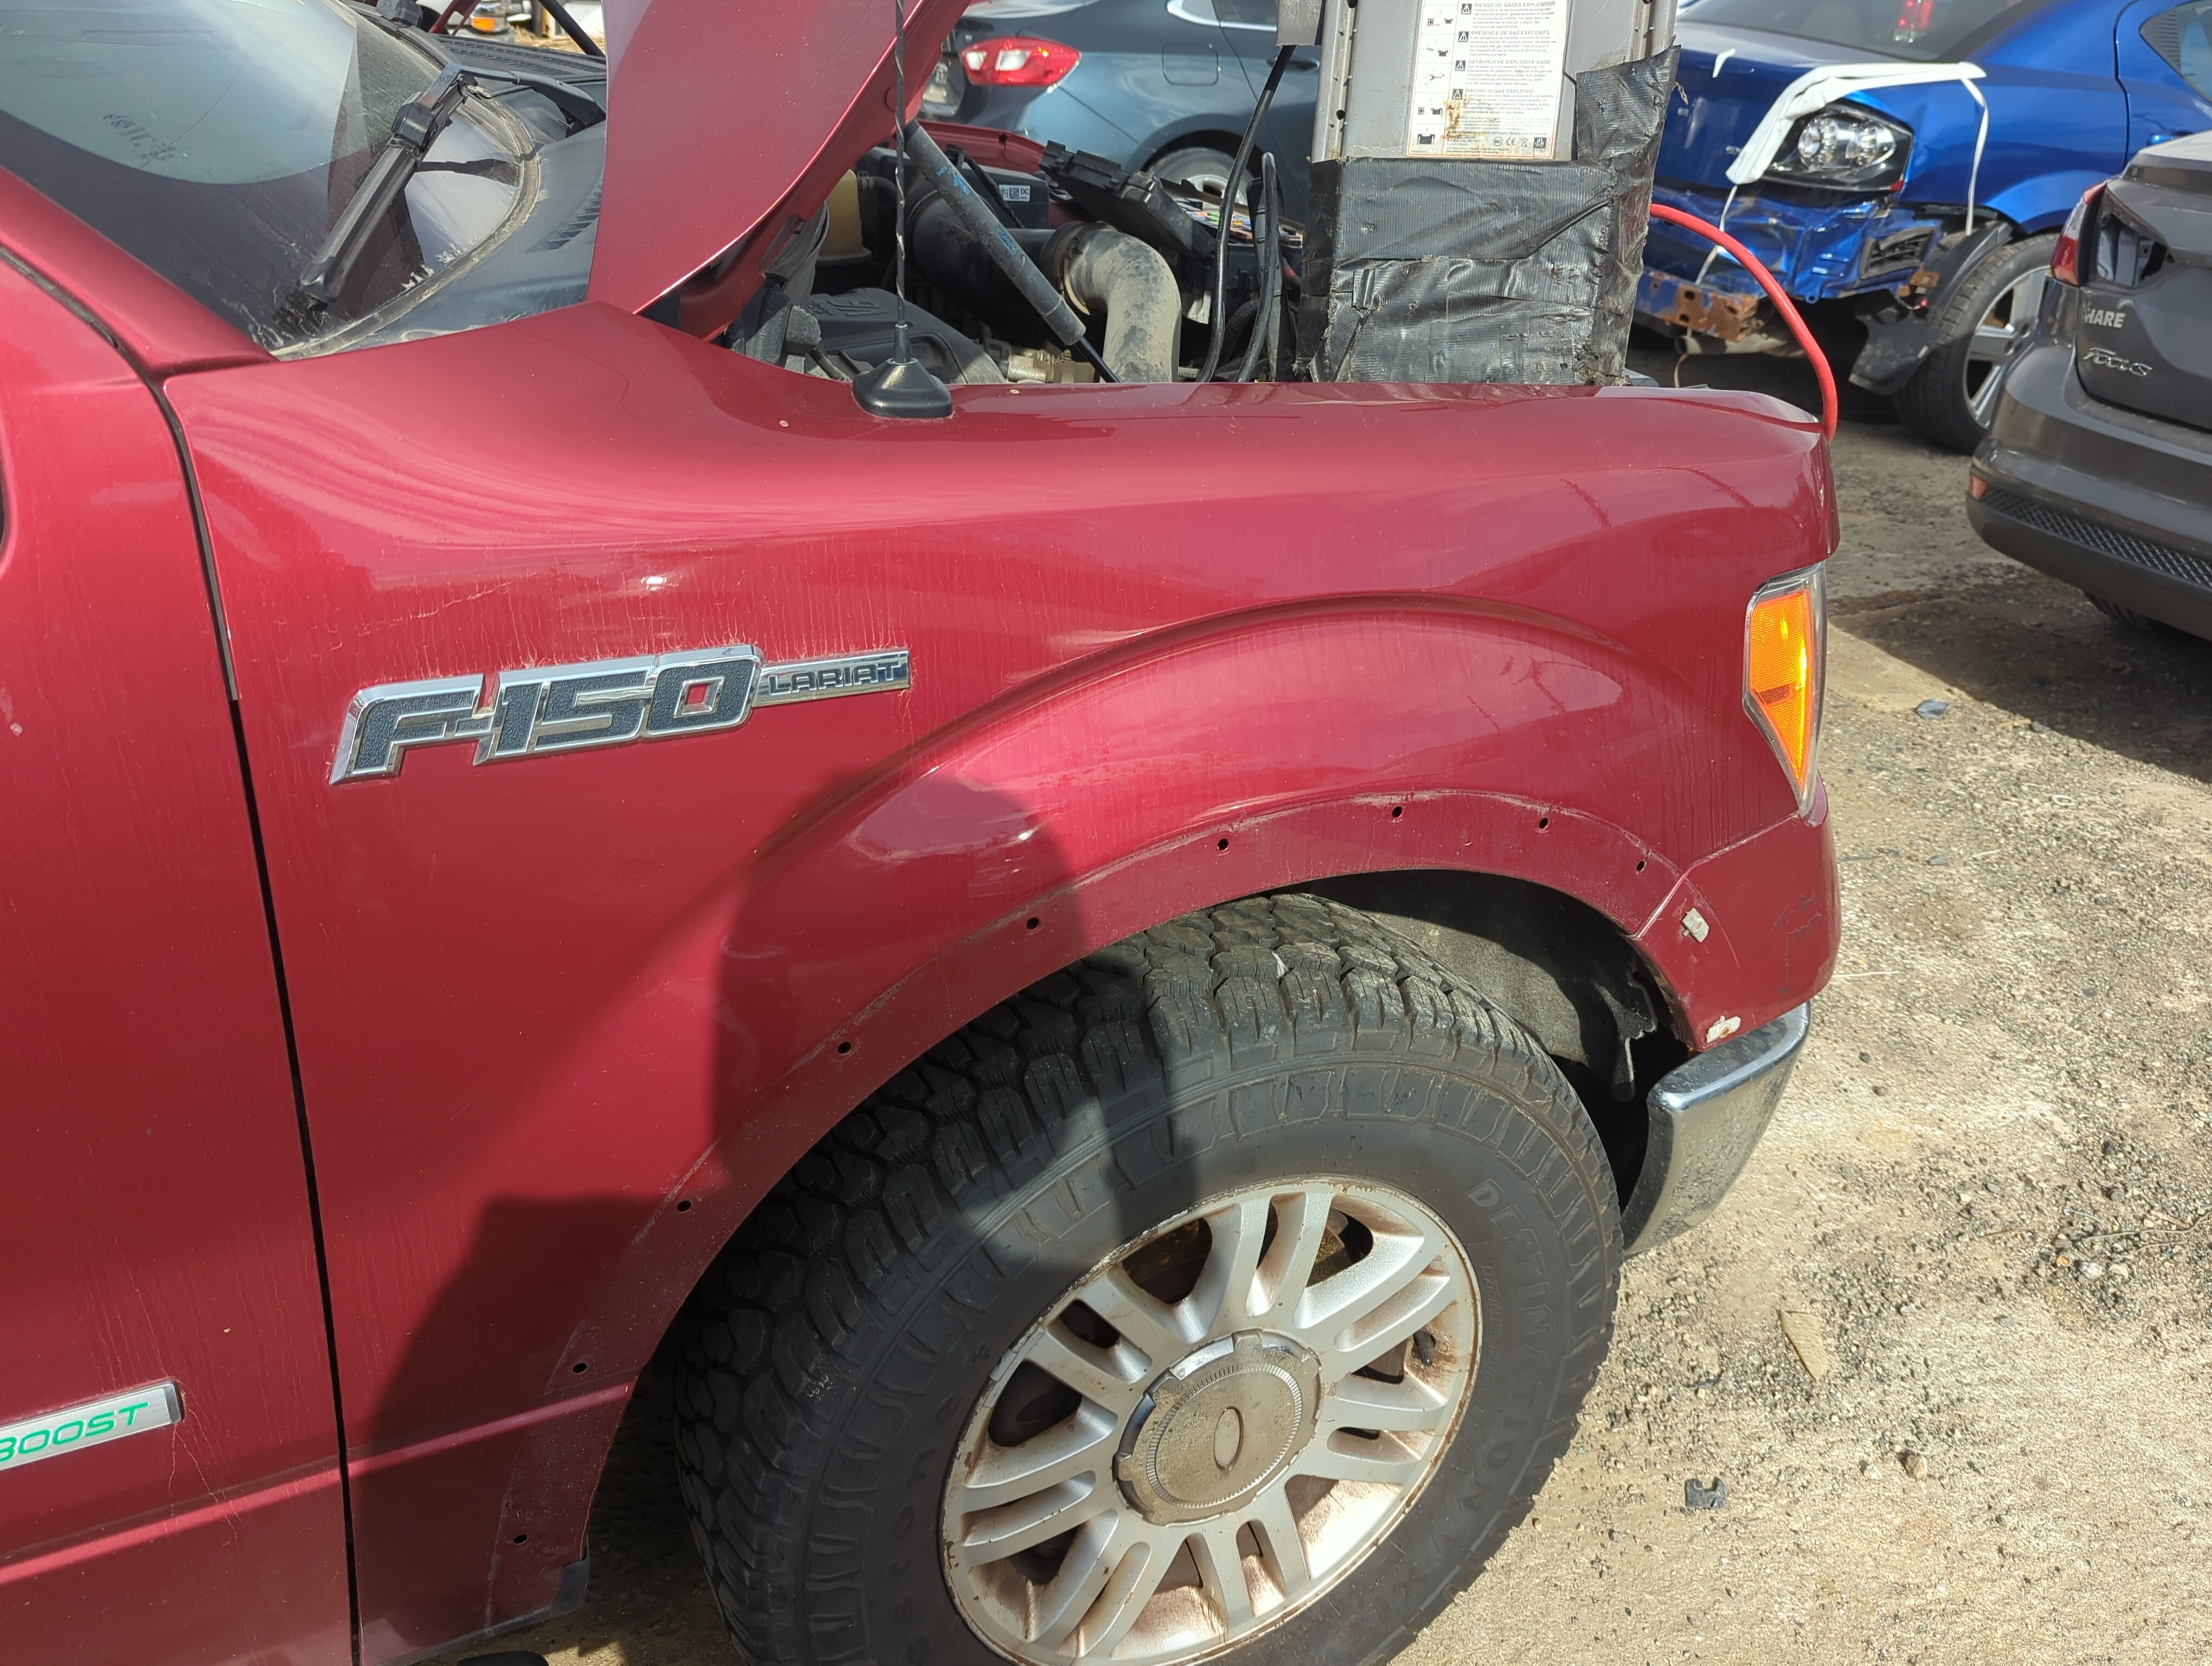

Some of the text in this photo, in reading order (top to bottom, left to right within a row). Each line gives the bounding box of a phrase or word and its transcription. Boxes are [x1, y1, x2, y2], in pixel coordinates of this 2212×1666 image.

[329, 644, 902, 786] F-150 LARIAT
[1459, 1177, 1553, 1513] DESTINATION
[892, 1392, 962, 1666] estone
